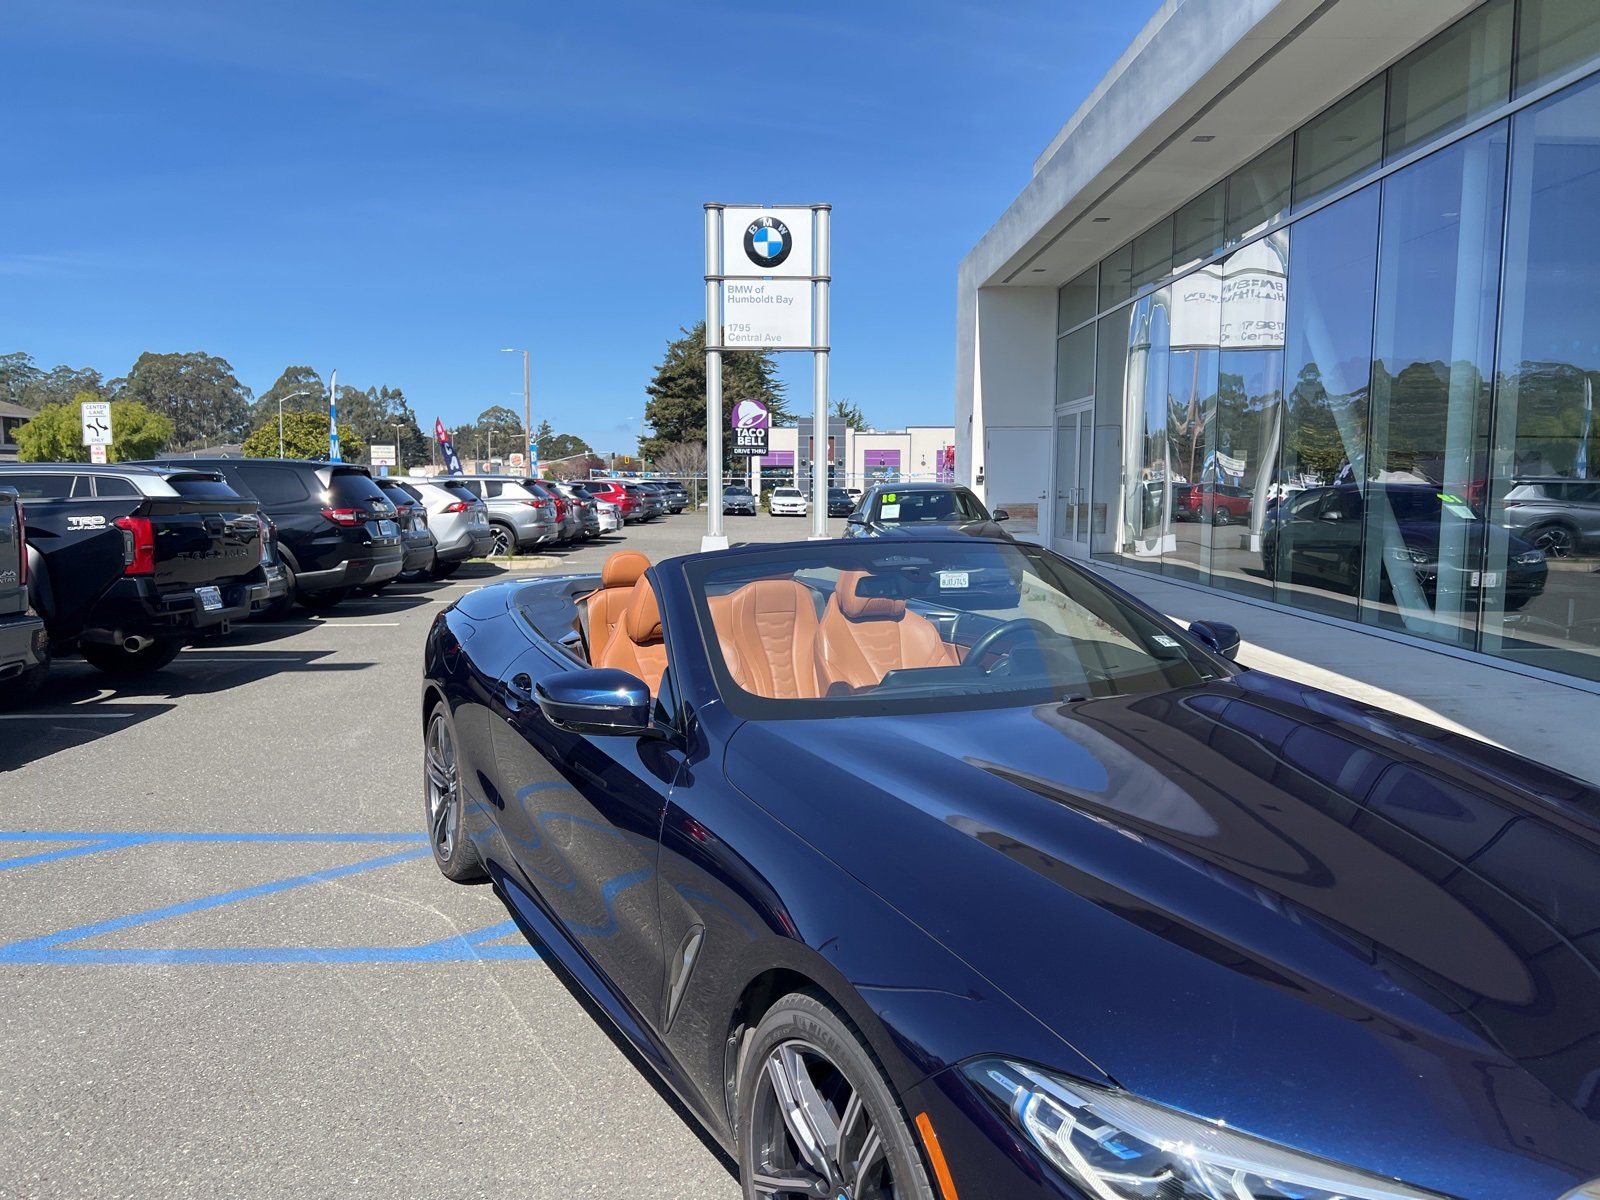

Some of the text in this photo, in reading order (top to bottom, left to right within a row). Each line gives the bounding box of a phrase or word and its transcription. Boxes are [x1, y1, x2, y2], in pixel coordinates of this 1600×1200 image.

[748, 217, 788, 235] BMW
[727, 285, 765, 294] BMW of
[727, 295, 794, 305] Humboldt Bay
[728, 323, 751, 332] 1795
[728, 332, 782, 342] Central Ave
[735, 428, 765, 437] TACO
[737, 436, 765, 446] BELL
[67, 516, 105, 526] TRD
